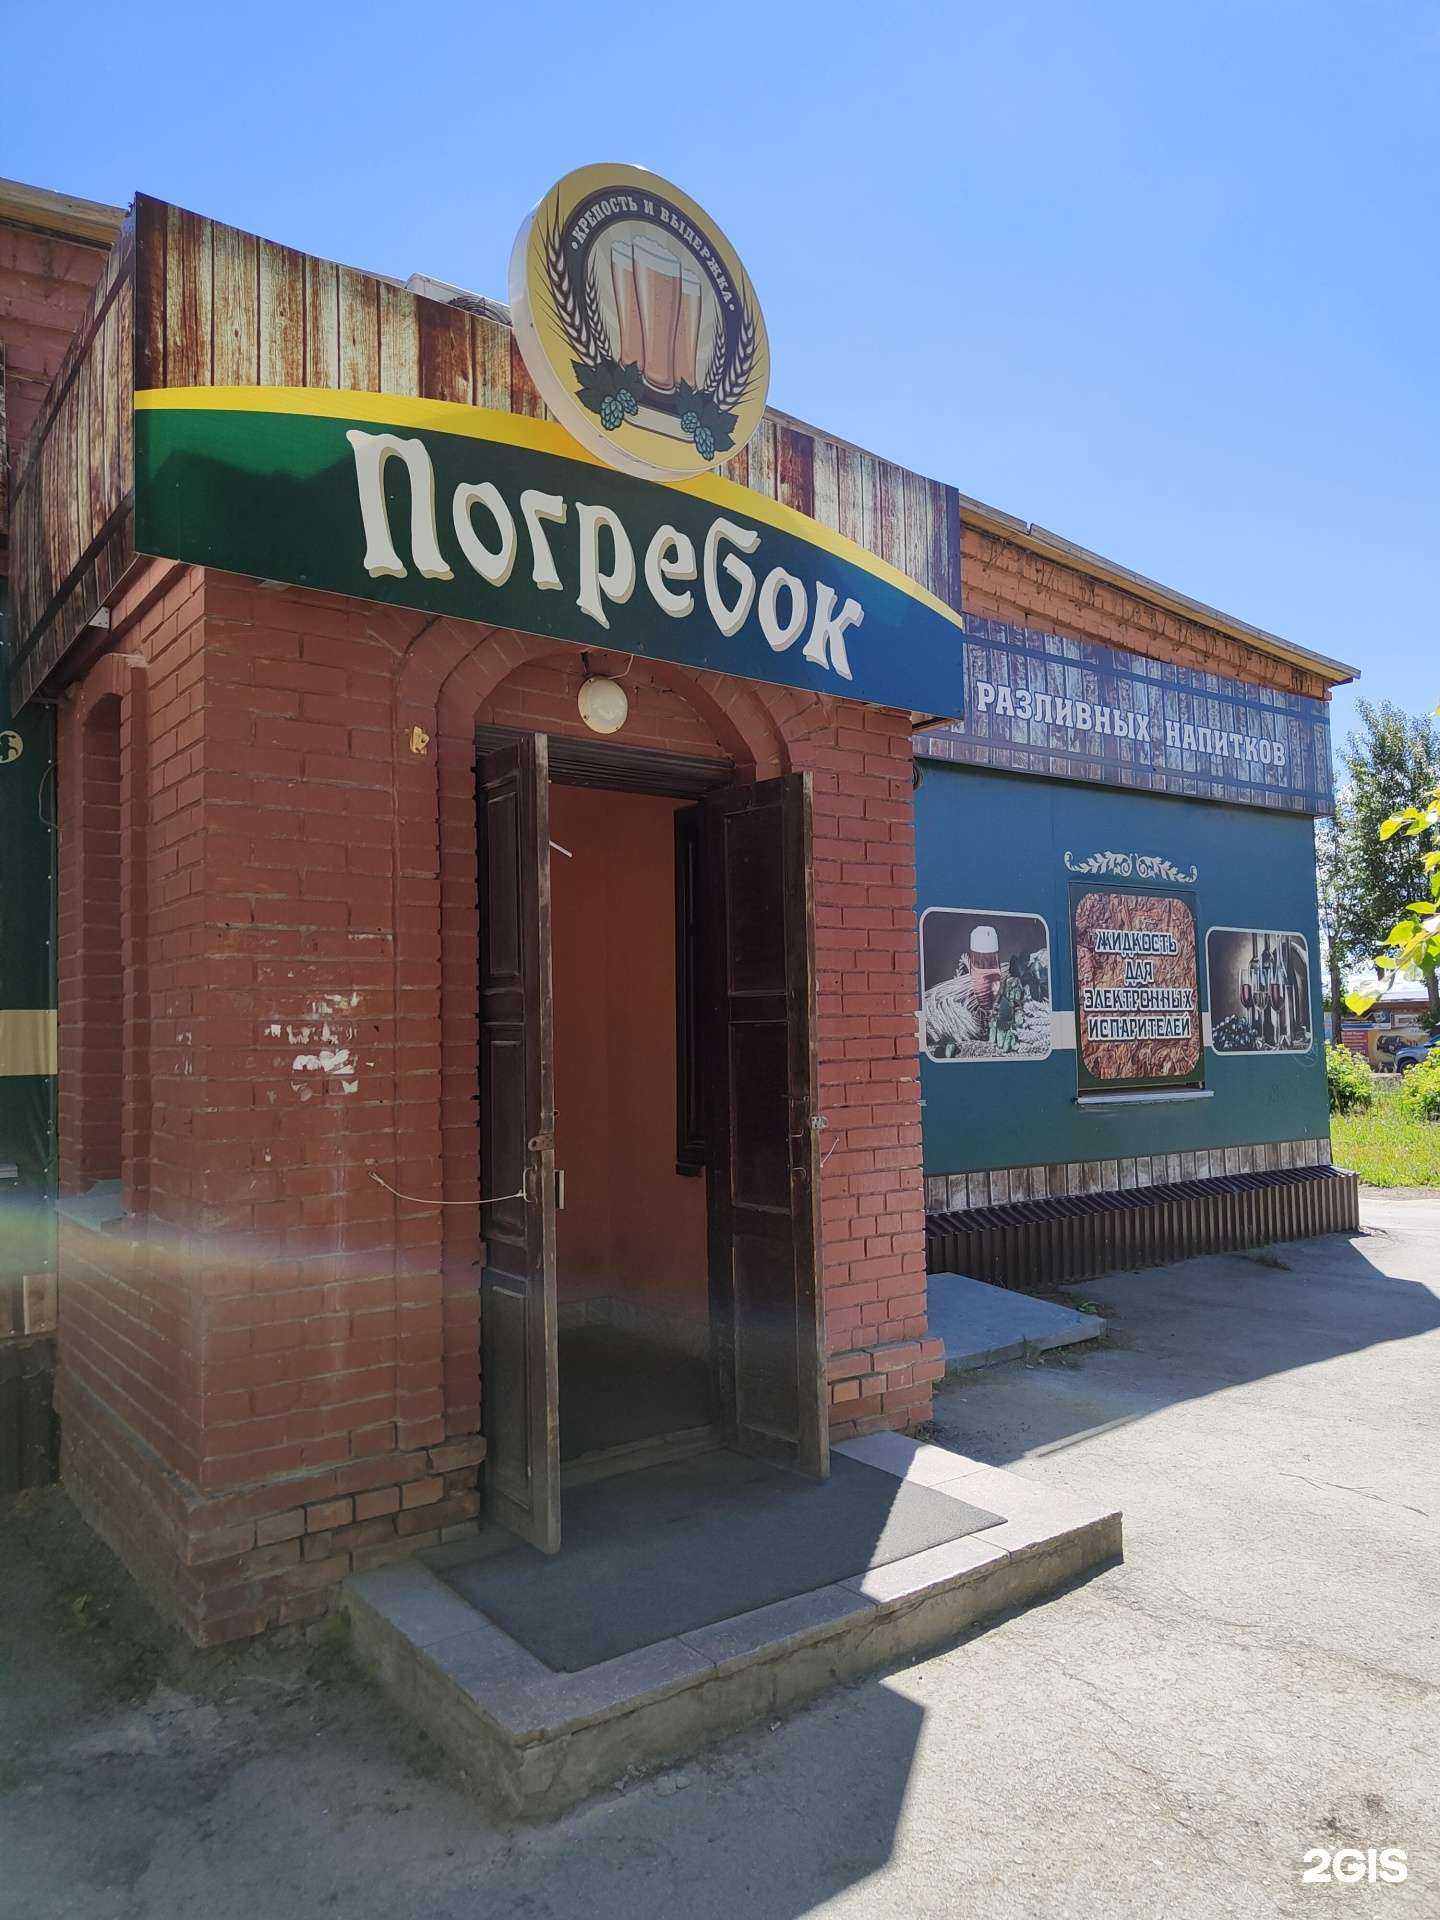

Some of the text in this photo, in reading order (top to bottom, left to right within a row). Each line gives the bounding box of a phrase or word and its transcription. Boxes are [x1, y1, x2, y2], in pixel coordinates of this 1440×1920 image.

[572, 196, 732, 303] КРЕПОСТЬ И ВЫДЕРЖКА
[976, 681, 1287, 767] РАЗЛИВНЫХ НАПИТКОВ
[1096, 930, 1178, 957] ЖИДКОСТЬ
[1125, 960, 1153, 985] ДЛЯ
[1084, 988, 1193, 1011] ЭЛЕКТРОННЫХ
[1088, 1013, 1191, 1040] ИСПАРИТЕЛЕЙ
